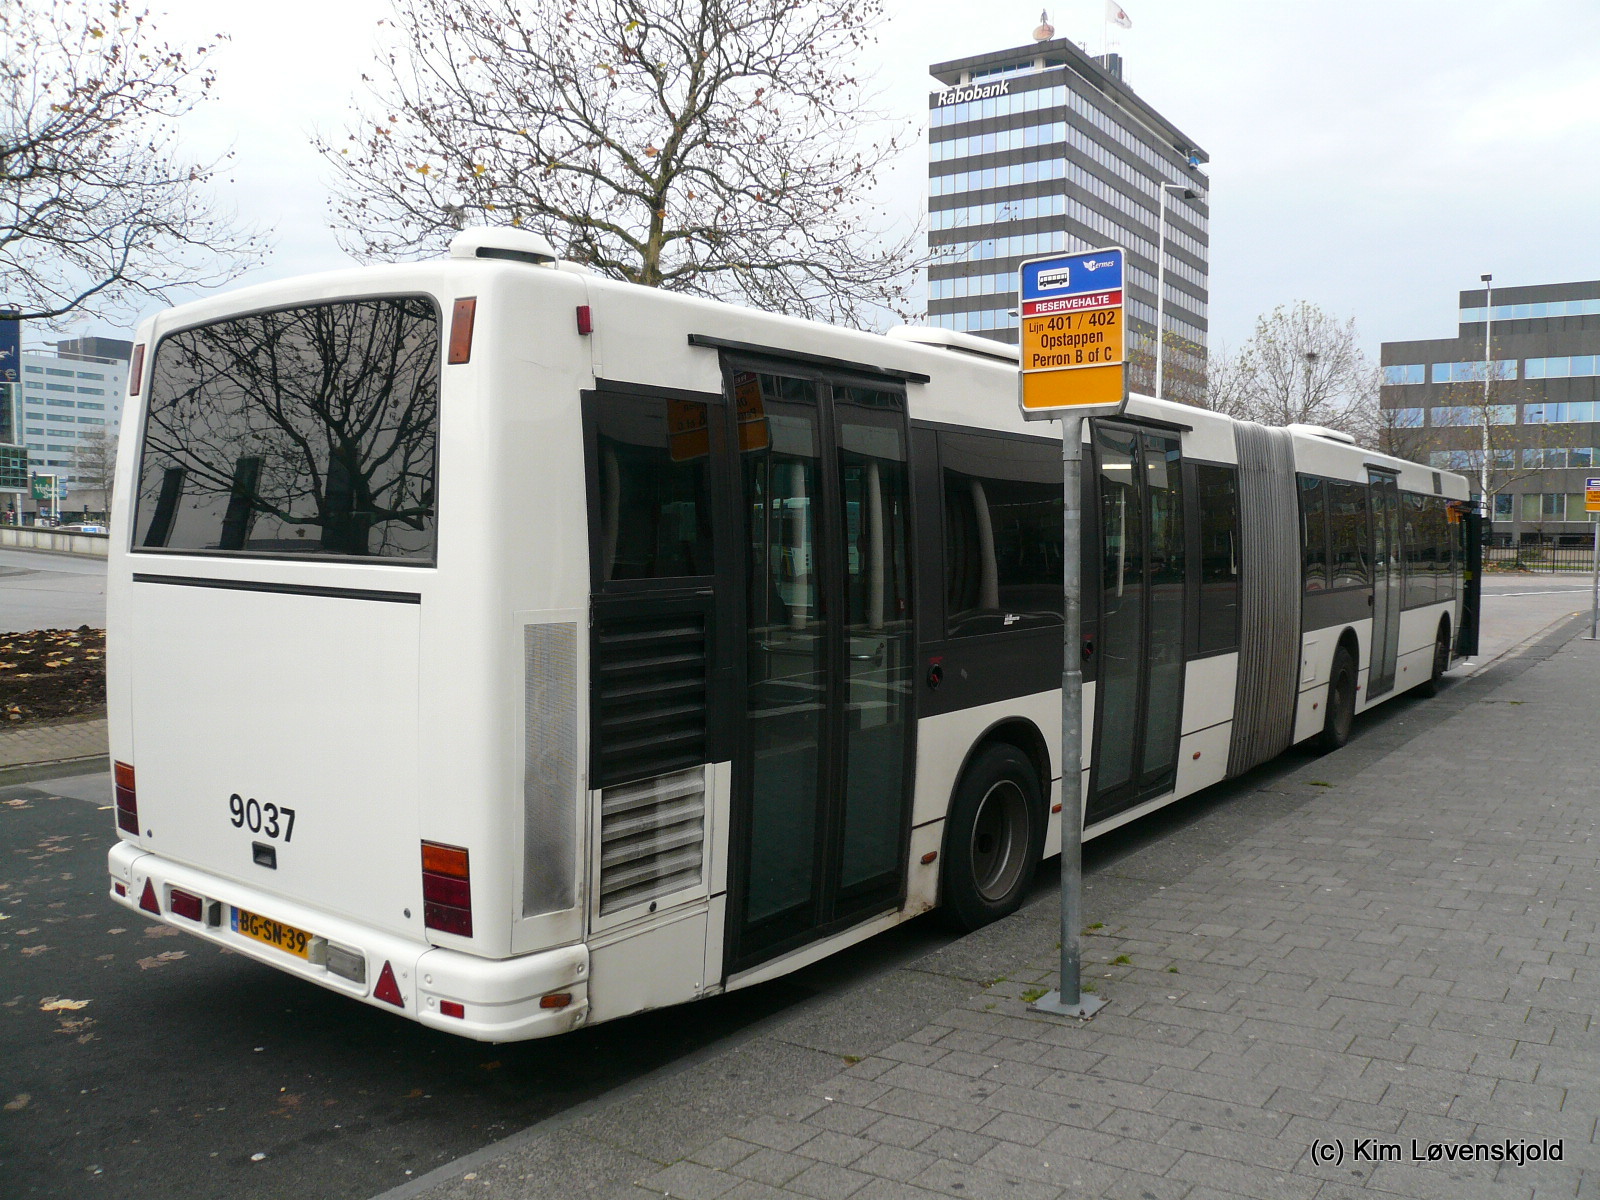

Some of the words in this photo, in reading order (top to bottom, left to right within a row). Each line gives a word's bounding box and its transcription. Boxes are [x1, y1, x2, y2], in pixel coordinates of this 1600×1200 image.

[937, 80, 1010, 106] Rabobank
[1035, 295, 1110, 312] RESERVEHALTE
[1029, 322, 1044, 334] Lijn
[1047, 315, 1072, 331] 401
[1077, 313, 1084, 330] /
[1088, 311, 1115, 327] 402
[1040, 331, 1103, 350] Opstappen
[1032, 353, 1070, 367] Perron
[1075, 349, 1083, 363] B
[1088, 348, 1100, 362] of
[1104, 346, 1112, 361] C
[229, 793, 296, 843] 9037
[240, 911, 306, 953] BG-SN-39
